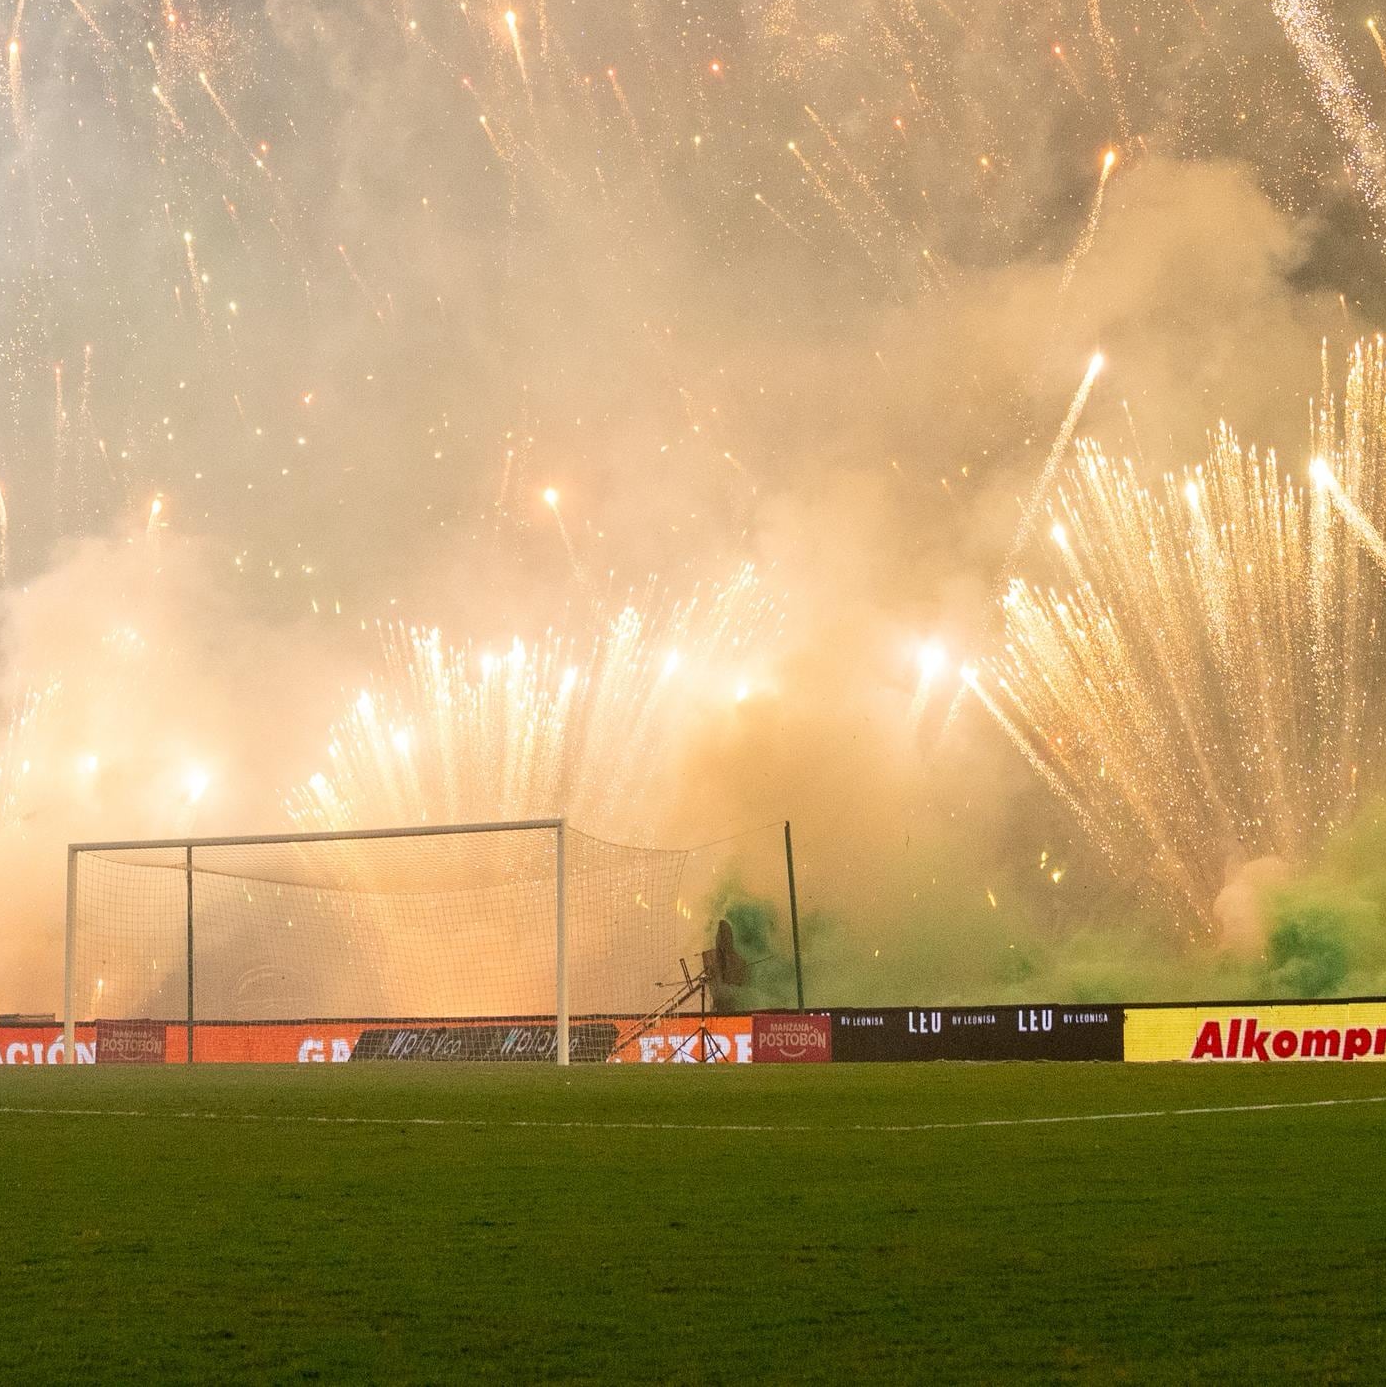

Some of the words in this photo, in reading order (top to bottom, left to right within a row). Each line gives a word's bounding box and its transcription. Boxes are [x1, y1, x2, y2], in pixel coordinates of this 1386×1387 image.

[840, 1016, 851, 1026] BY
[853, 1016, 884, 1026] LEONISA
[952, 1015, 961, 1025] BY
[964, 1014, 996, 1025] LEONISA
[1063, 1013, 1073, 1023] BY
[1075, 1013, 1109, 1024] LEONISA
[770, 1023, 810, 1032] MANZANA
